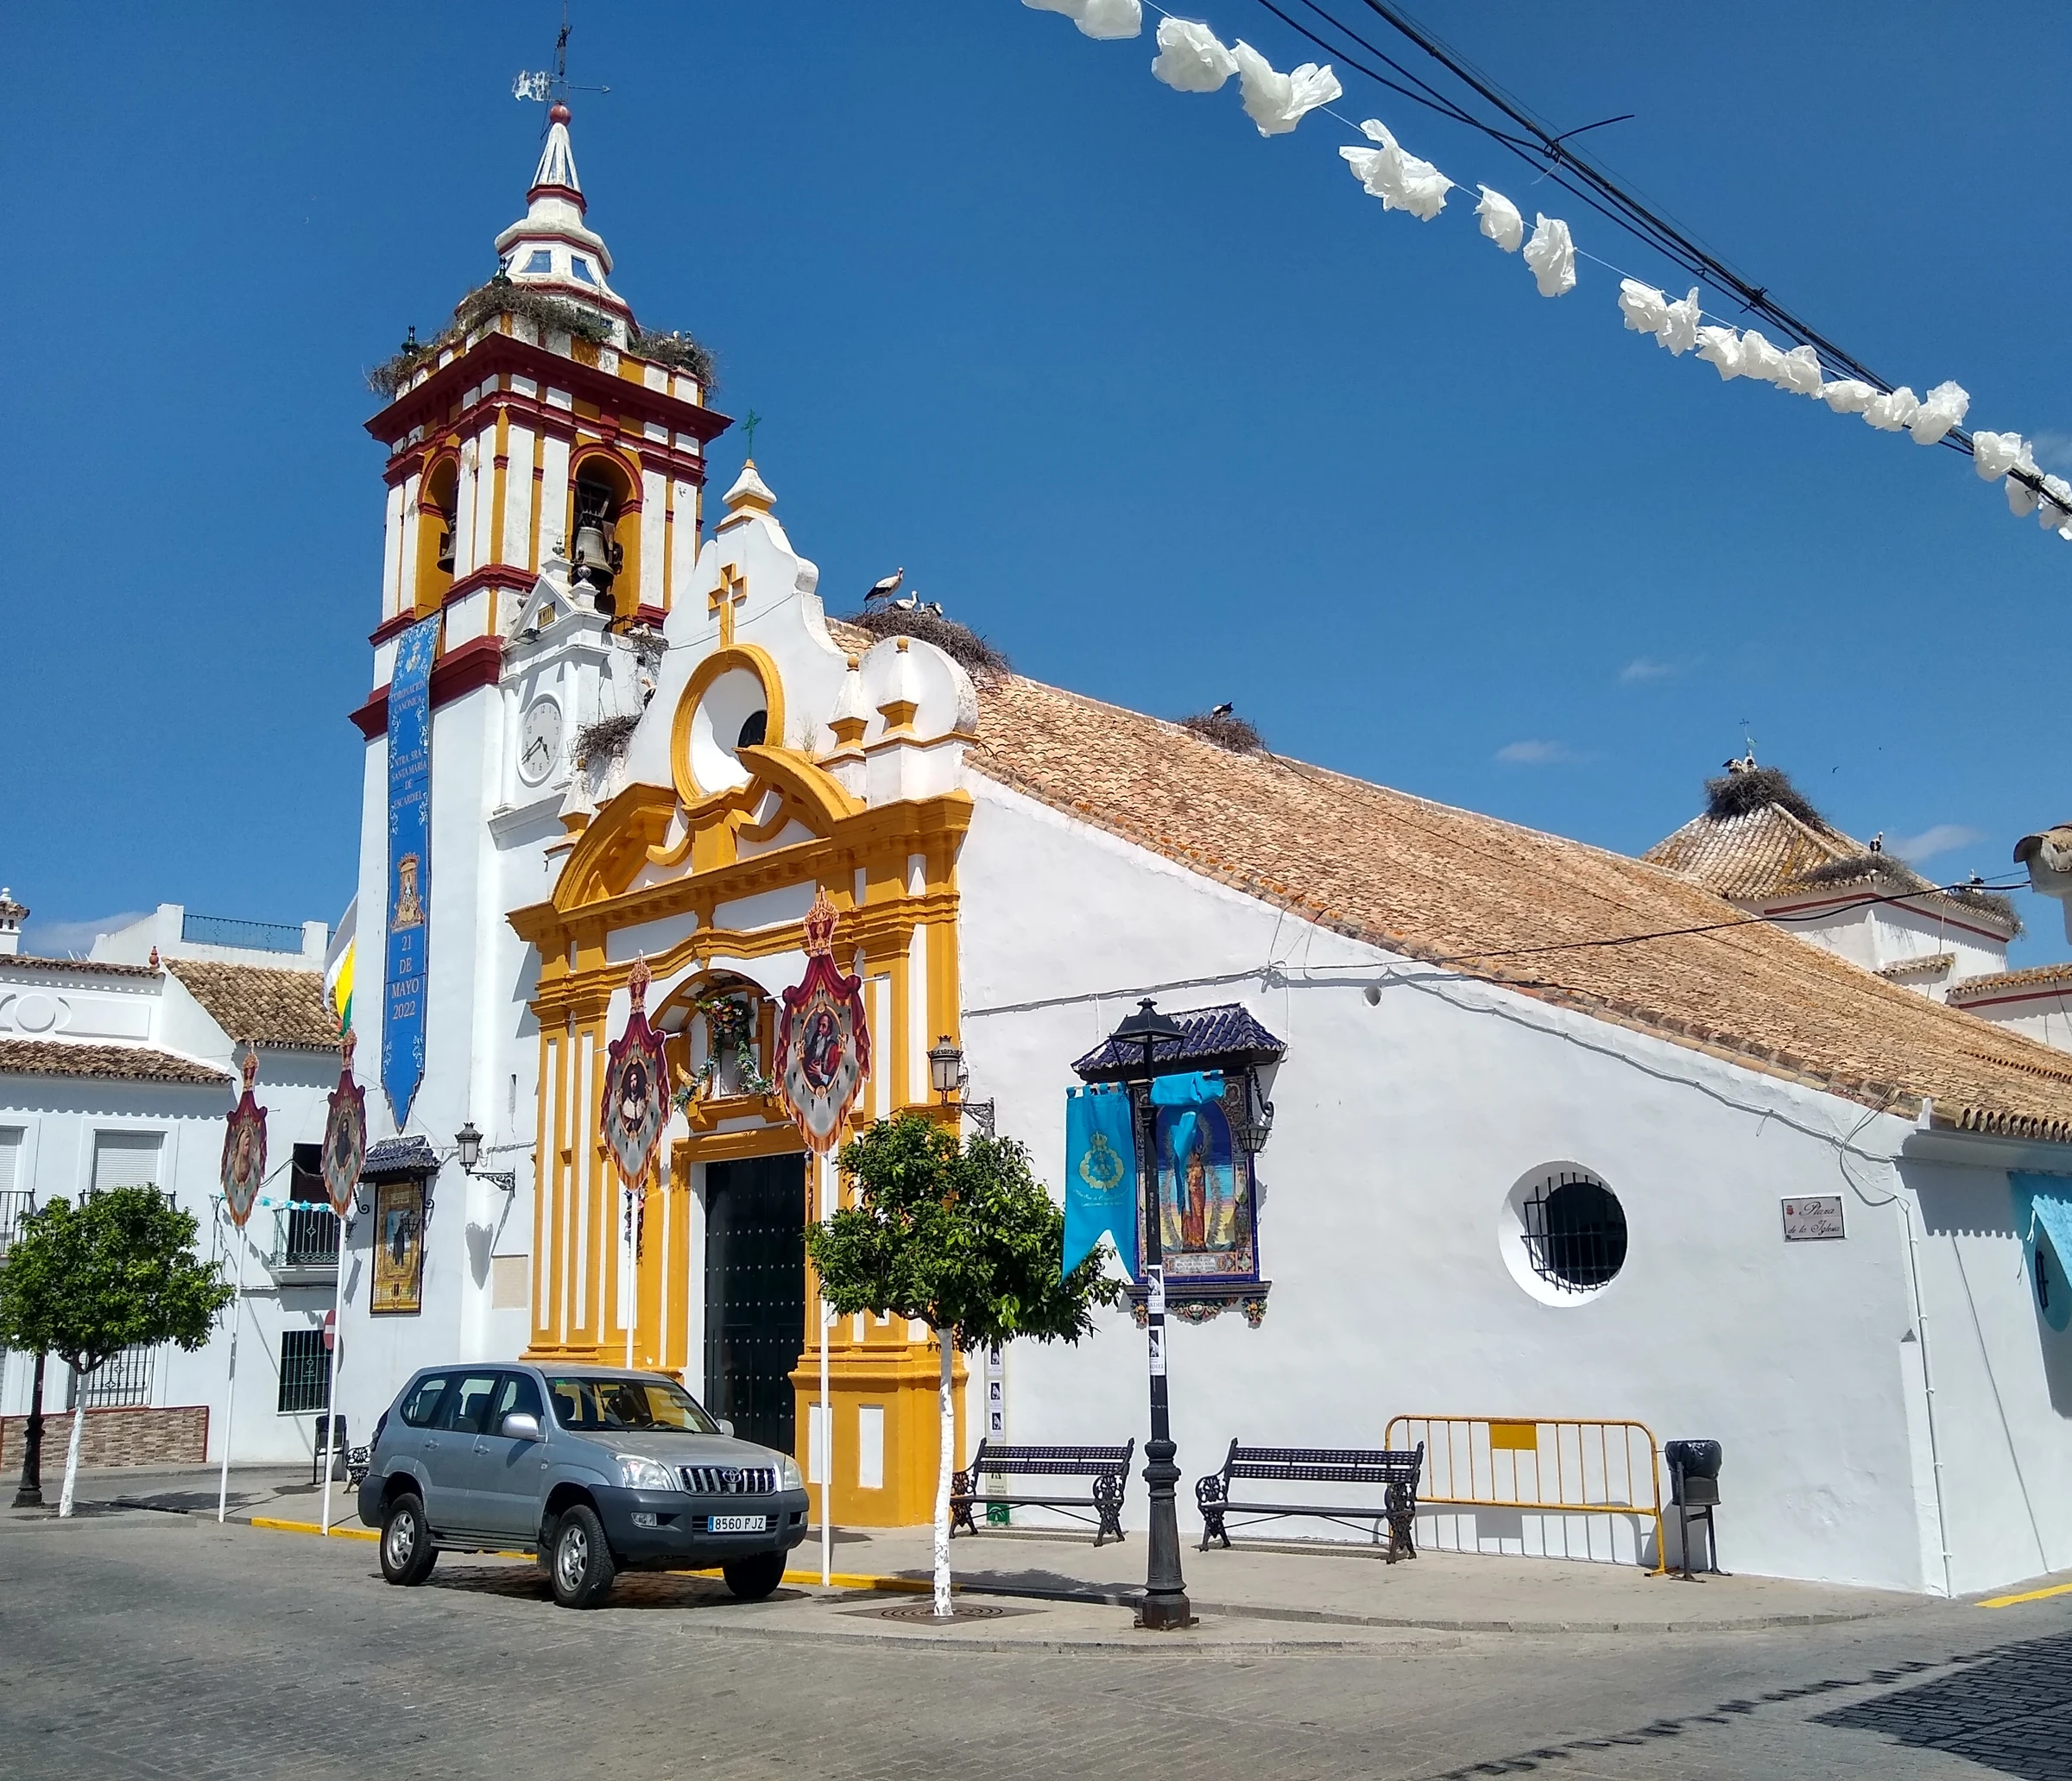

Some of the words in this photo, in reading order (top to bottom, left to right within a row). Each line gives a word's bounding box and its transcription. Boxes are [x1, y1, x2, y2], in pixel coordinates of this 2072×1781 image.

[540, 704, 546, 714] 12
[391, 767, 408, 782] SANTA
[405, 779, 413, 790] DE
[394, 790, 423, 810] ESCARDIEL
[401, 934, 412, 951] 21
[399, 957, 412, 974] DE
[391, 978, 420, 999] MAYO
[392, 1001, 416, 1020] 2022
[1798, 1201, 1835, 1216] Plaza
[1787, 1225, 1797, 1234] de
[1798, 1225, 1807, 1234] la
[1810, 1220, 1841, 1236] Iglesia
[715, 1518, 742, 1530] 8560
[744, 1518, 764, 1530] FJZ
